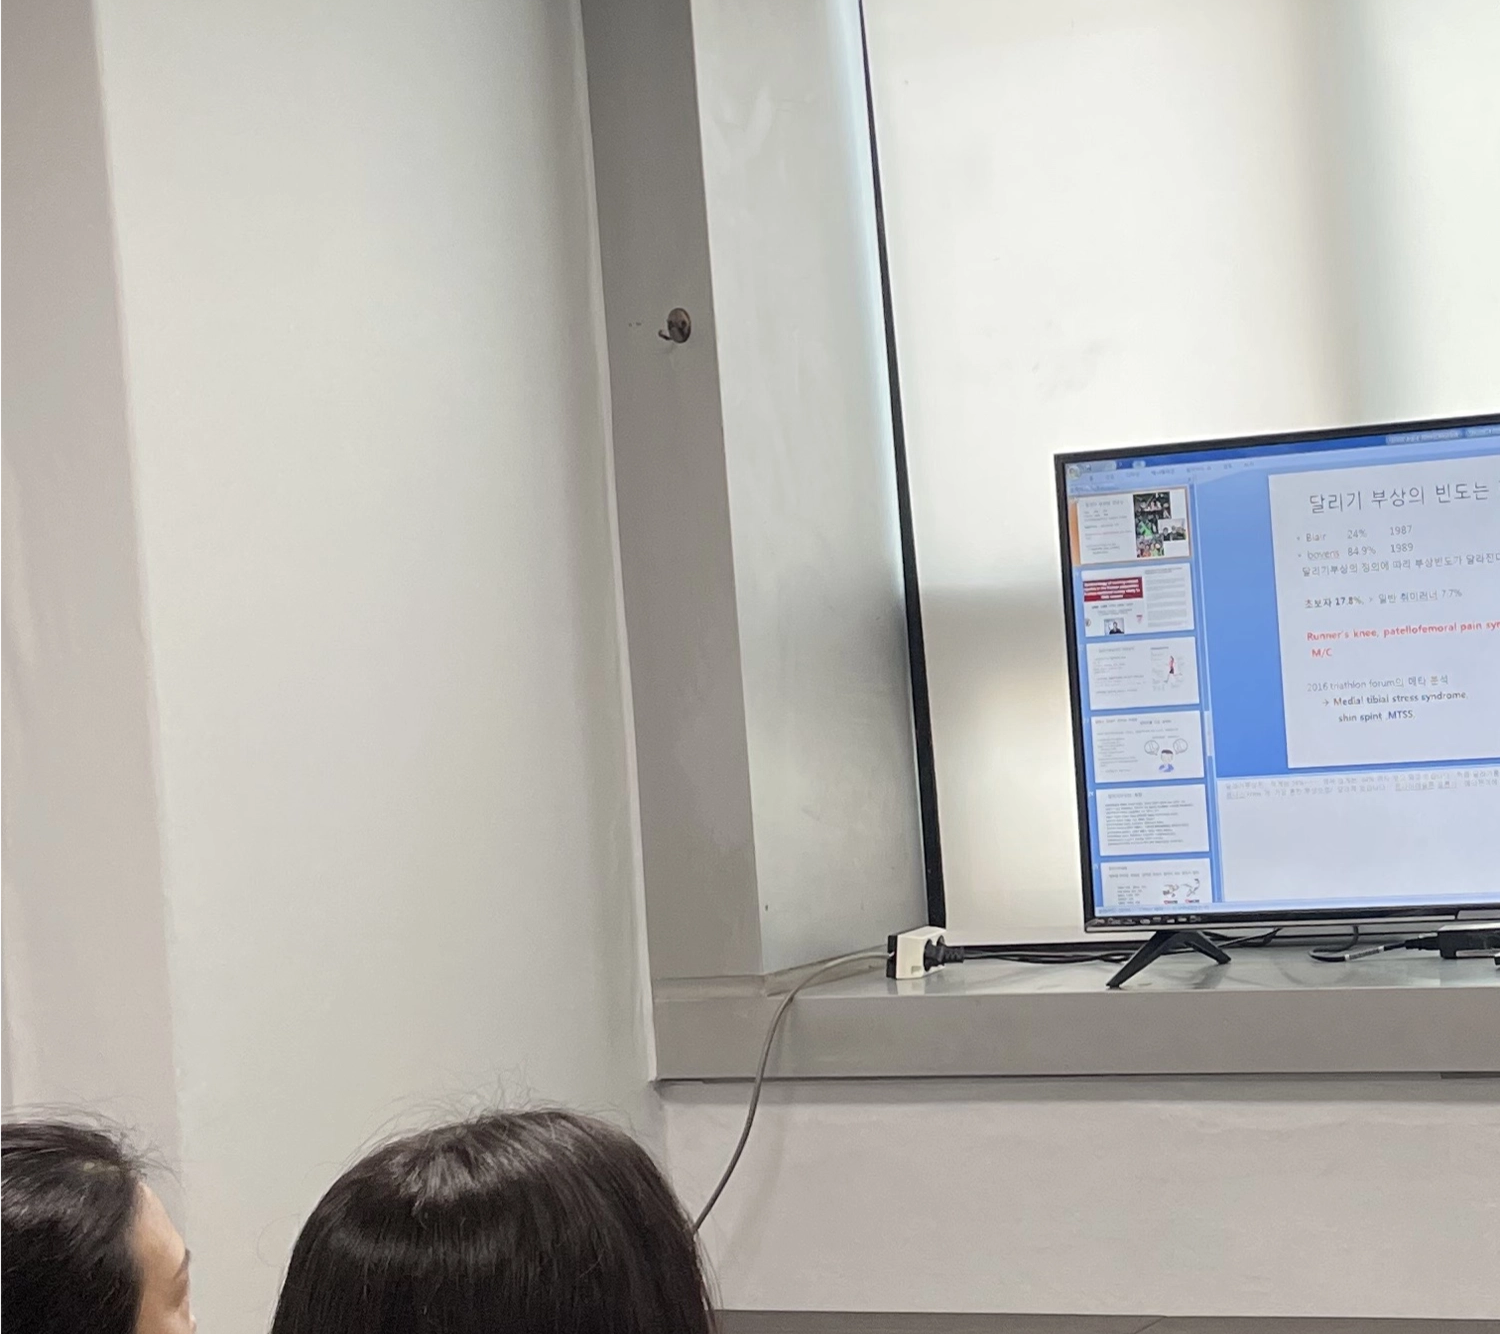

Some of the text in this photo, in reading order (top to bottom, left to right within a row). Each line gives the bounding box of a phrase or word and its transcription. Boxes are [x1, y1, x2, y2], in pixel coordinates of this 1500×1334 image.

[1309, 491, 1362, 514] 달리기
[1371, 486, 1425, 509] 부상의
[1435, 482, 1489, 504] 빈도는
[1347, 529, 1368, 539] 24%
[1390, 525, 1412, 536] 1987
[1390, 543, 1414, 554] 1989
[1305, 598, 1332, 608] 초보자
[1307, 630, 1350, 642] Runner's
[1384, 623, 1457, 638] patellofemoral
[1460, 622, 1482, 633] pain
[1311, 647, 1333, 658] M/C
[1307, 682, 1329, 693] 2016
[1330, 679, 1367, 691] triathlon
[1368, 677, 1405, 689] forum의
[1333, 696, 1364, 706] Medial
[1366, 694, 1389, 705] tibial
[1392, 693, 1419, 703] stress
[1338, 713, 1357, 723] shin
